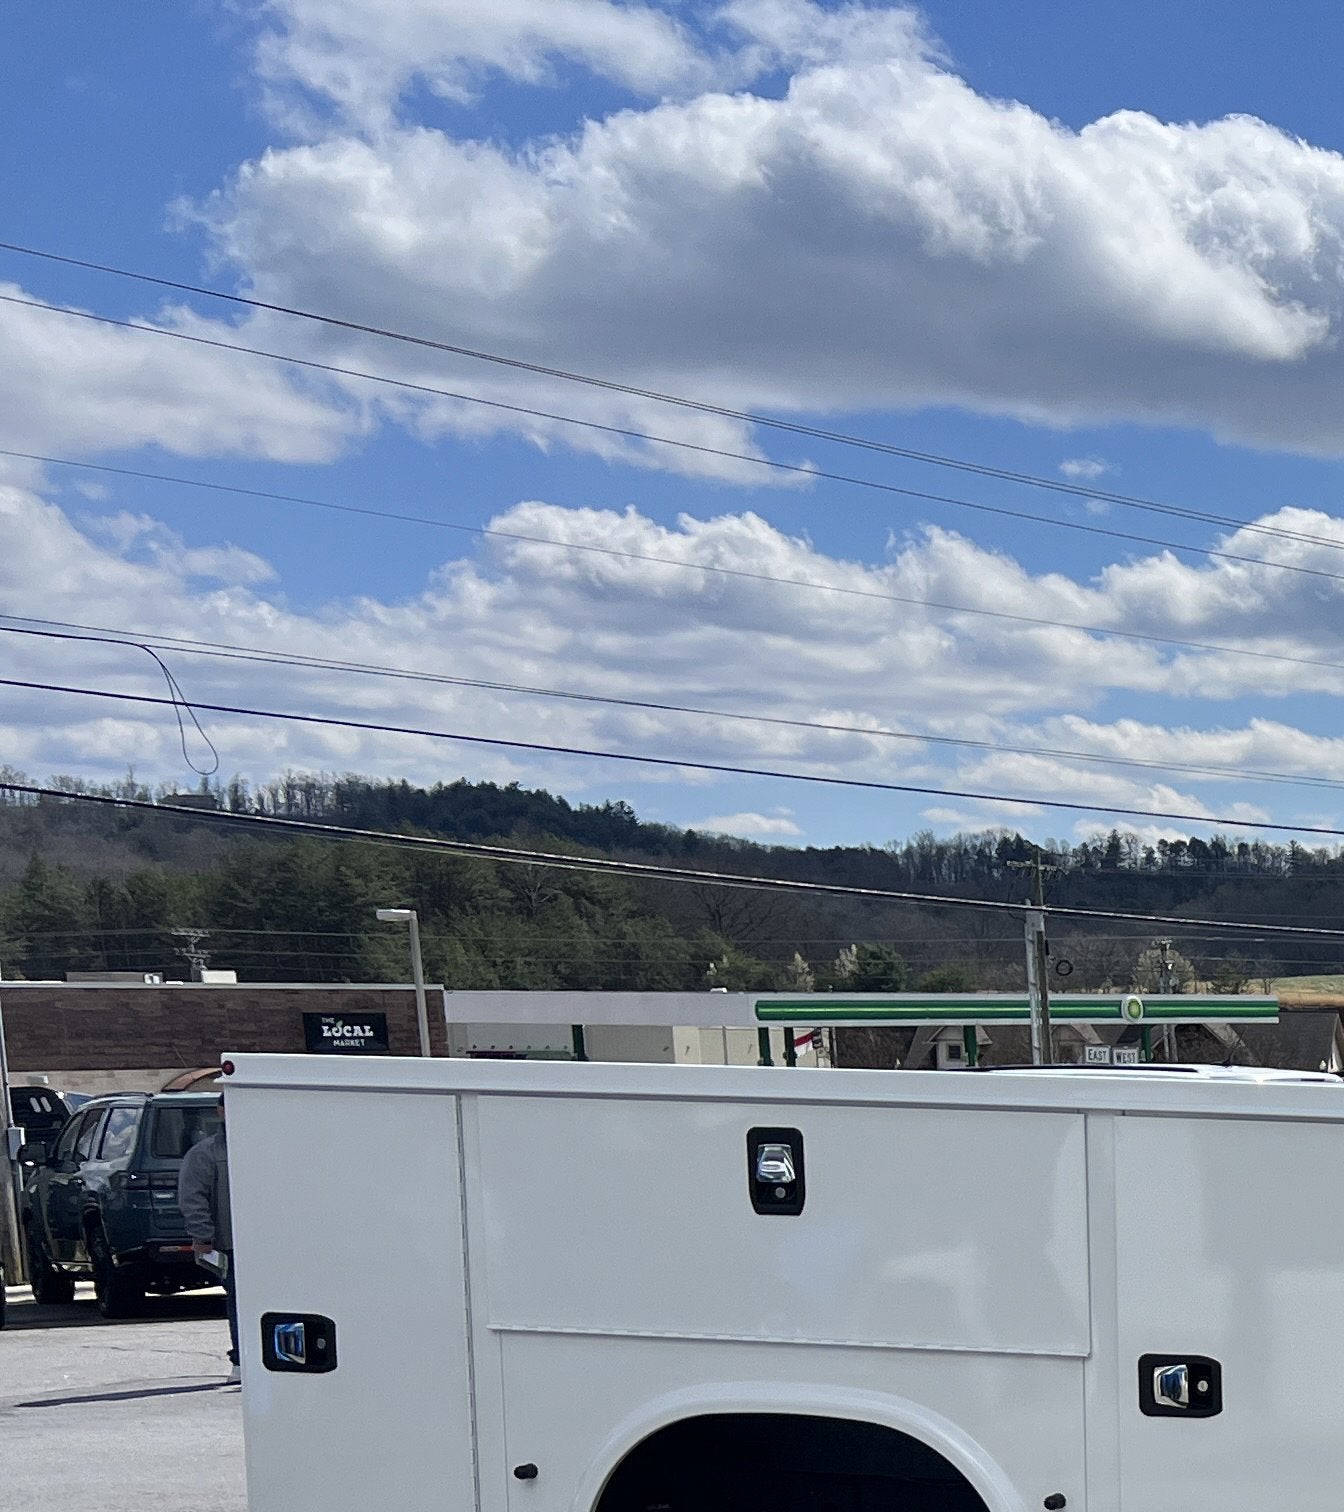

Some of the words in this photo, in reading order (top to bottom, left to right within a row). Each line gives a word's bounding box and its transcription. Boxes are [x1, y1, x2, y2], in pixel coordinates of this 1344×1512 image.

[321, 1025, 374, 1037] LOCAL
[333, 1039, 365, 1047] MARKET
[1088, 1048, 1107, 1062] EAST
[1115, 1052, 1136, 1064] WEST
